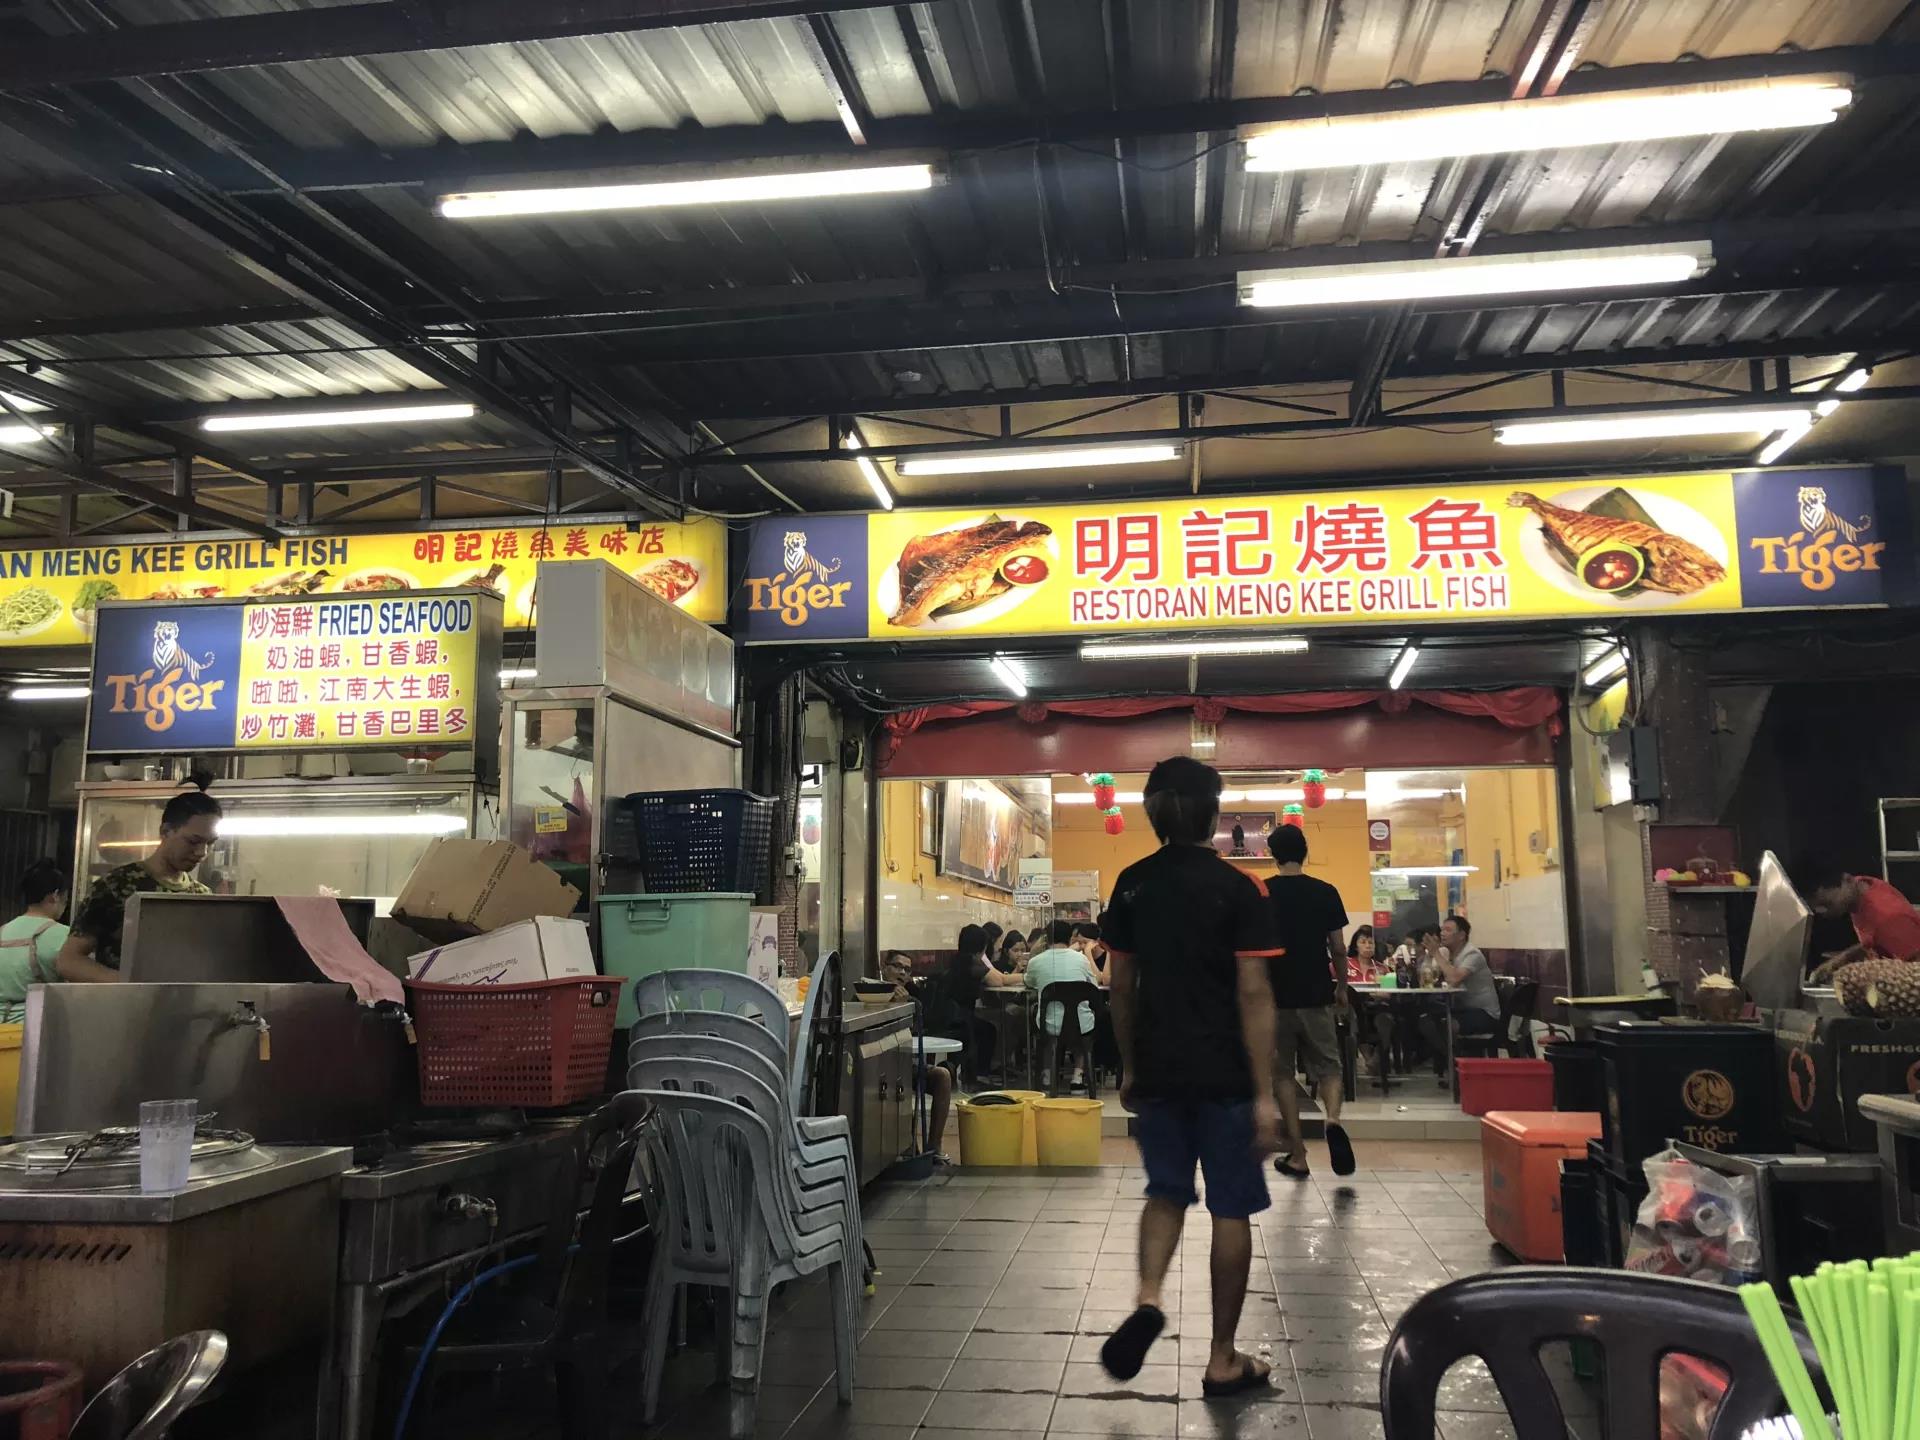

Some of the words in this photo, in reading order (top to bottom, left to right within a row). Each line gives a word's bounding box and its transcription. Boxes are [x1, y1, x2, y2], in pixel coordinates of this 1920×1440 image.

[42, 549, 121, 577] MENG
[131, 546, 185, 573] KEE
[195, 542, 276, 570] GRILL
[285, 539, 348, 566] FISH
[414, 526, 665, 563] 明記燒魚美味店
[1075, 498, 1502, 583] 明記燒魚
[1750, 532, 1886, 591] Tiger
[248, 606, 313, 639] 炒海鮮
[319, 604, 372, 636] FRIED
[379, 600, 471, 634] SEAFOOD
[744, 571, 851, 626] Tiger
[1073, 587, 1208, 621] RESTORAN
[1216, 584, 1290, 617] MENG
[1301, 583, 1350, 614] KEE
[1360, 579, 1437, 611] GRILL
[1447, 575, 1506, 609] FISH
[105, 668, 225, 732] Tiger
[1683, 1125, 1738, 1150] Tiger
